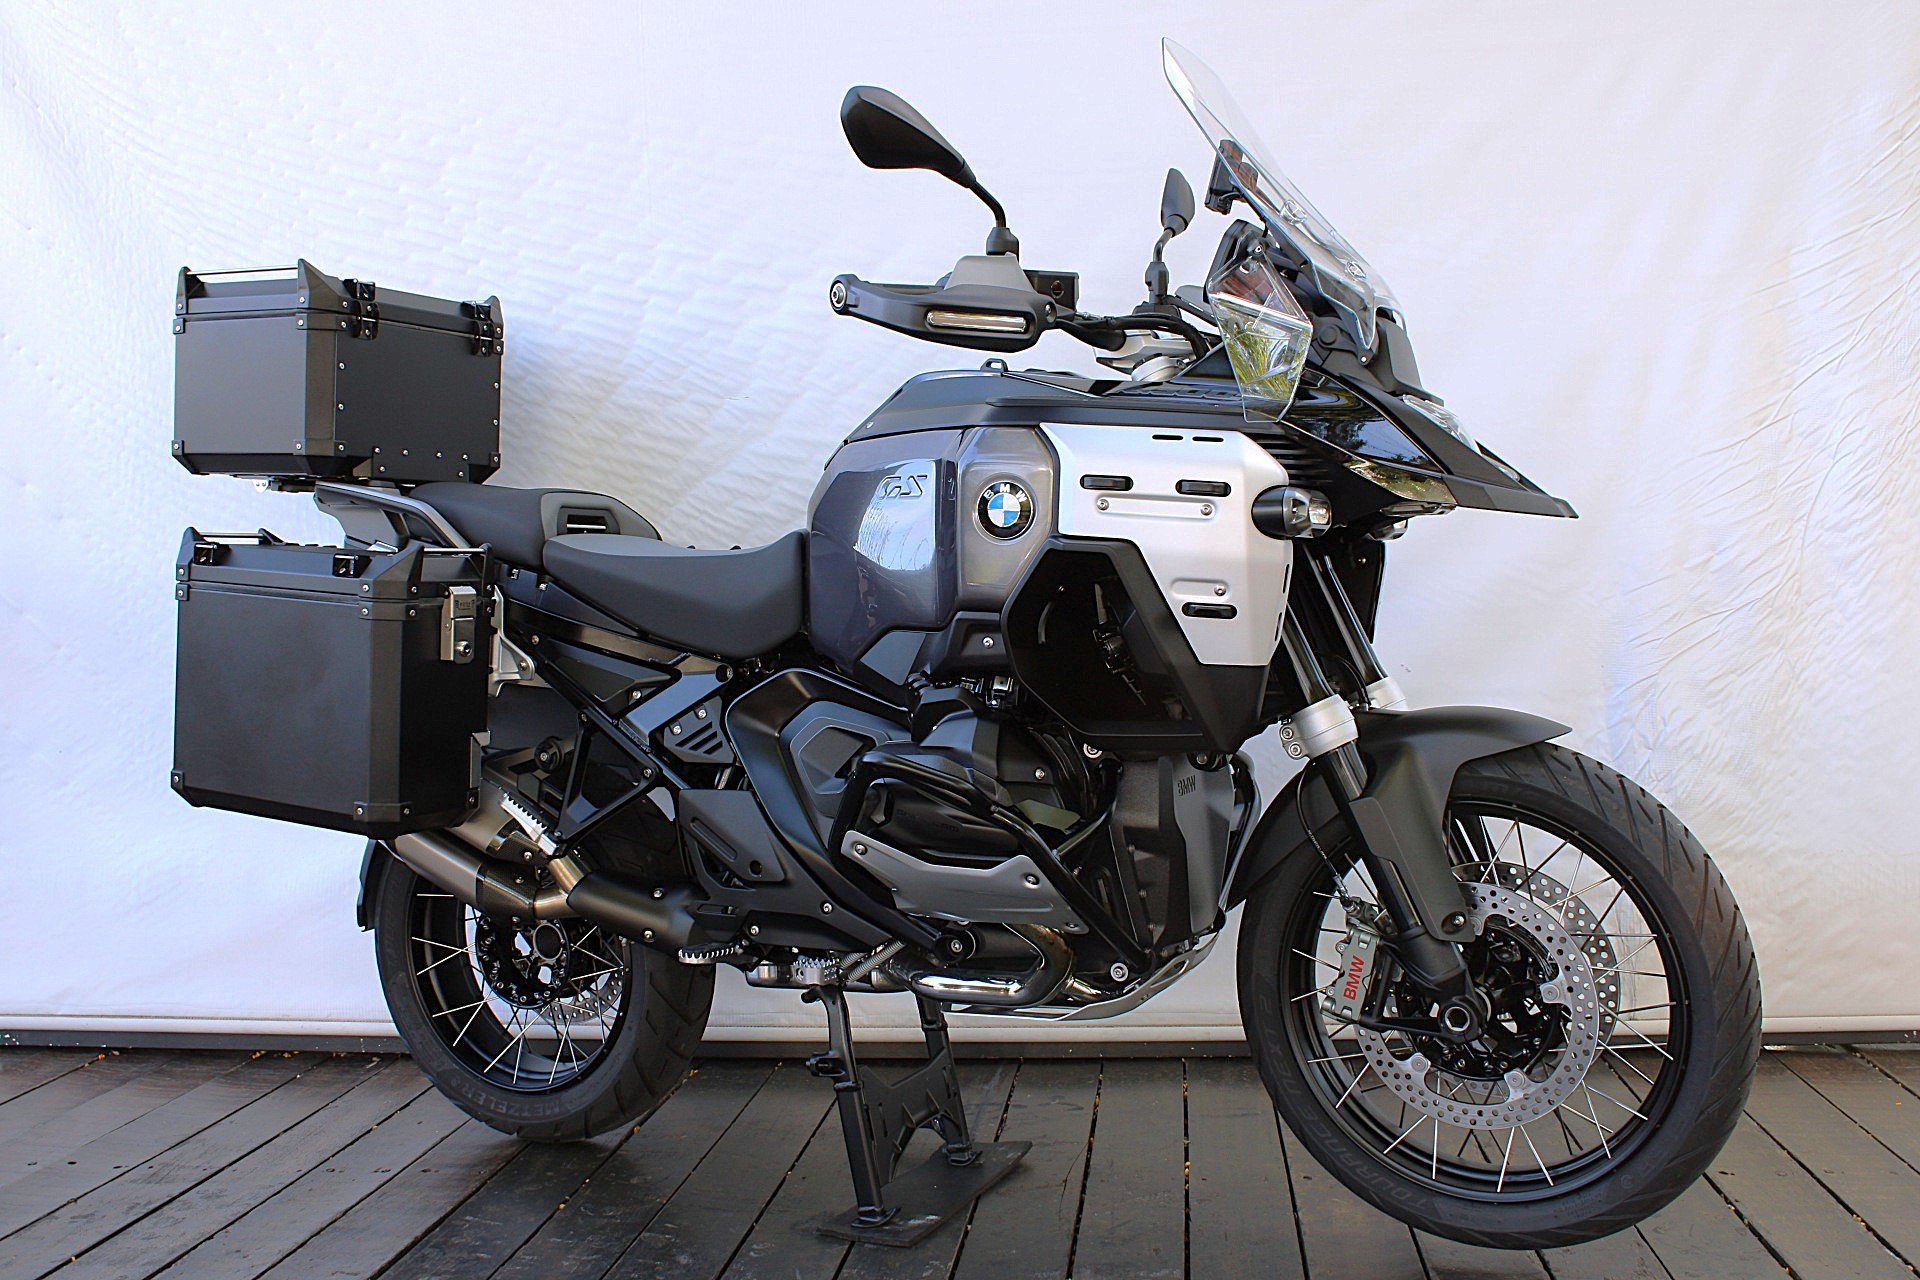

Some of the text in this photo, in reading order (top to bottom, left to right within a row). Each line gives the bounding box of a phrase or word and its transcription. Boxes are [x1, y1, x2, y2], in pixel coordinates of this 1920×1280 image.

[876, 474, 927, 499] GS
[983, 482, 1028, 502] BMW
[1177, 775, 1196, 796] BMW
[1343, 955, 1365, 1001] BMW
[461, 1082, 560, 1117] METZELER
[1299, 1106, 1427, 1208] TOURANCE
